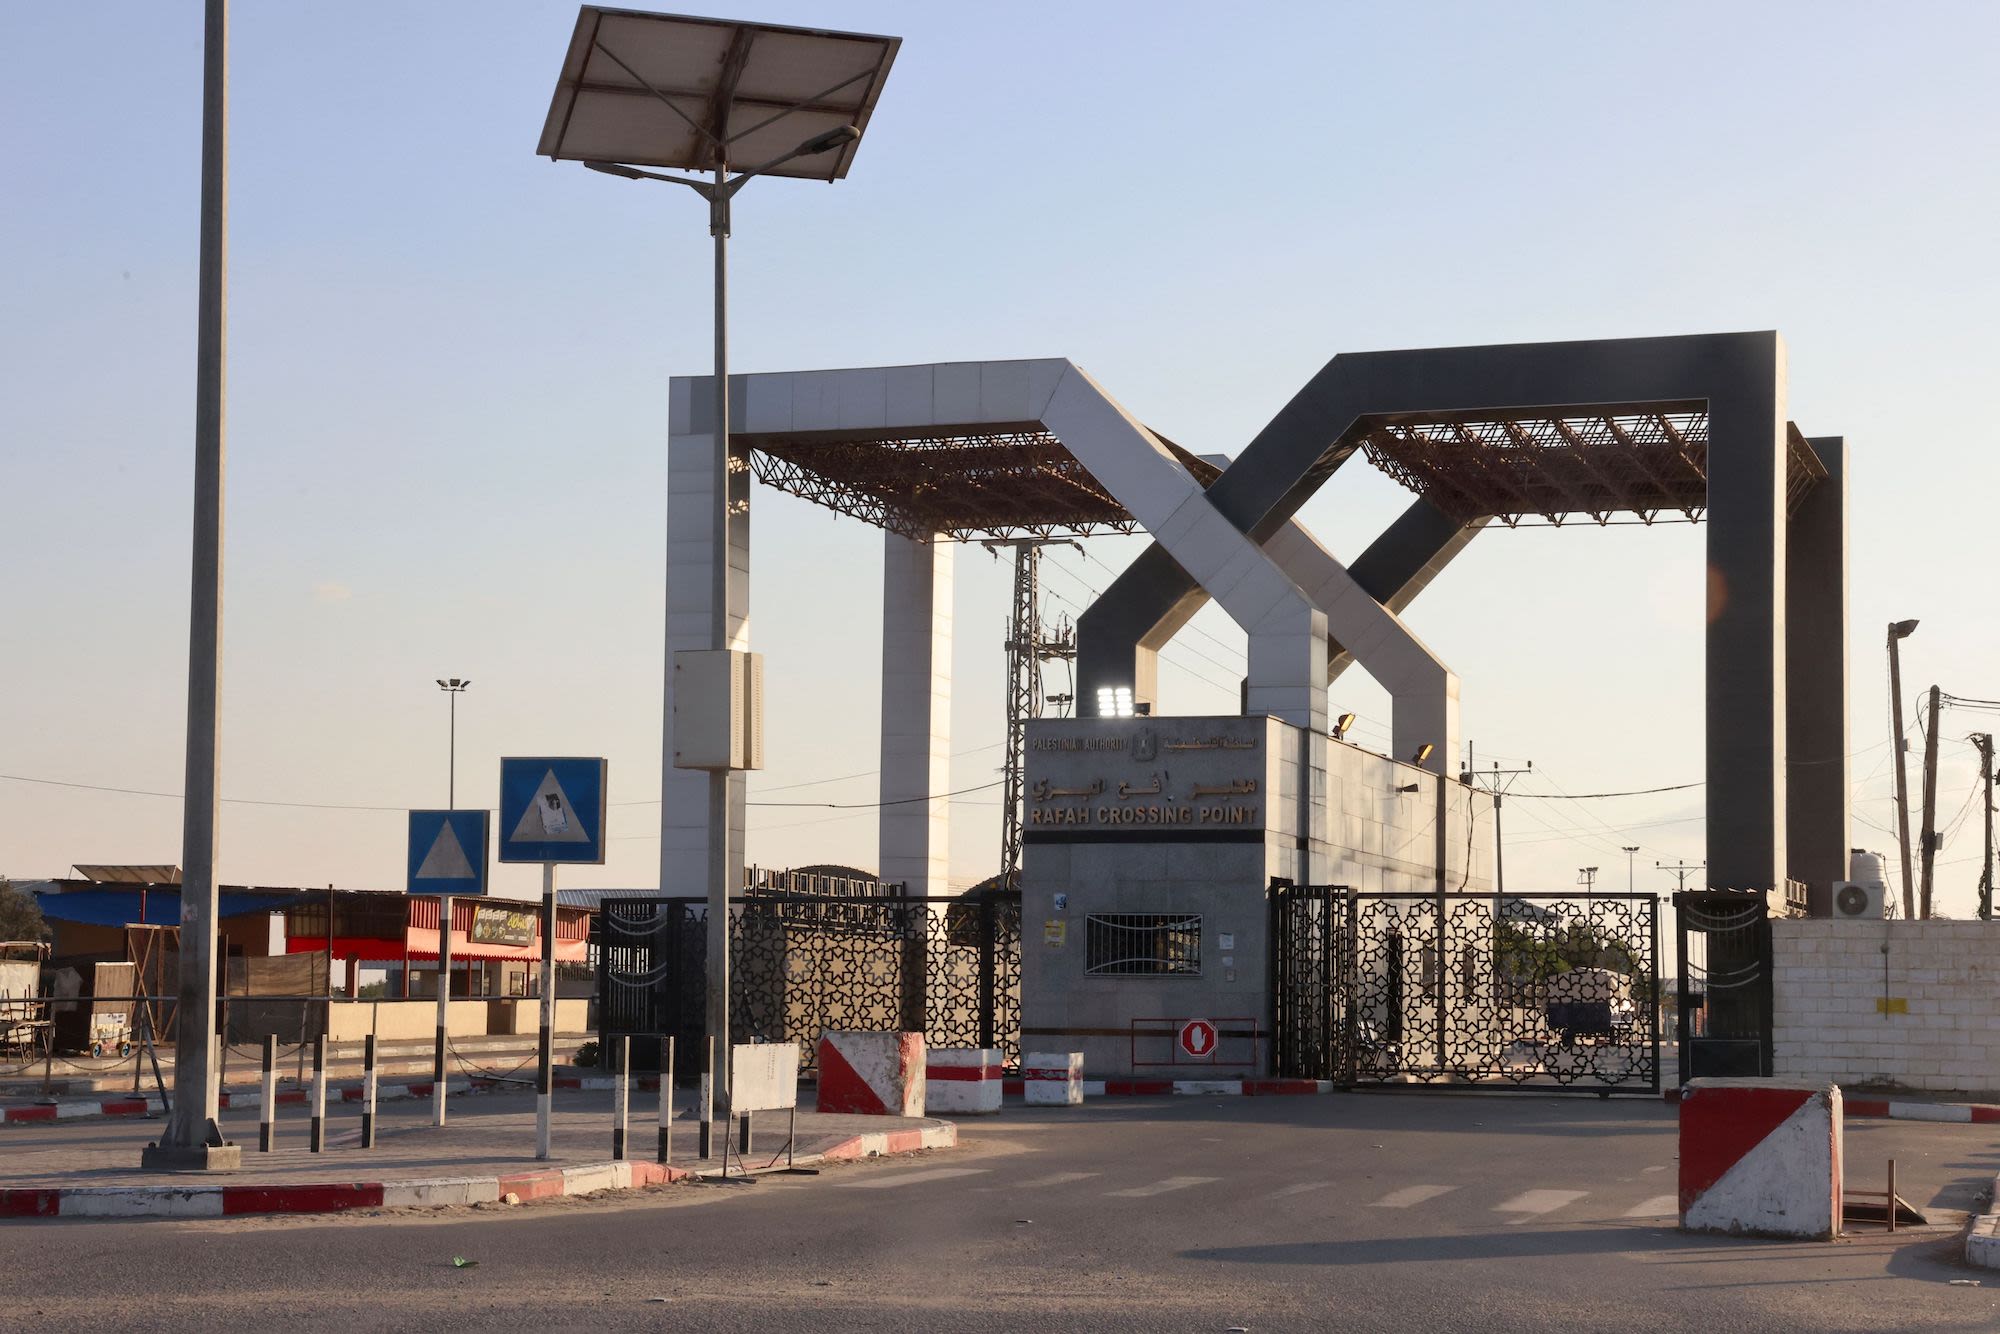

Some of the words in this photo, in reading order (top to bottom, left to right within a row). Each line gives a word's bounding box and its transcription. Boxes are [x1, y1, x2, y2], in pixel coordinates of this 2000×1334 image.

[1085, 736, 1129, 752] AUTHORITY
[1190, 777, 1257, 800] معبر
[1031, 807, 1090, 825] RAFAH
[1096, 806, 1192, 825] CROSSING
[1200, 806, 1257, 825] POINT
